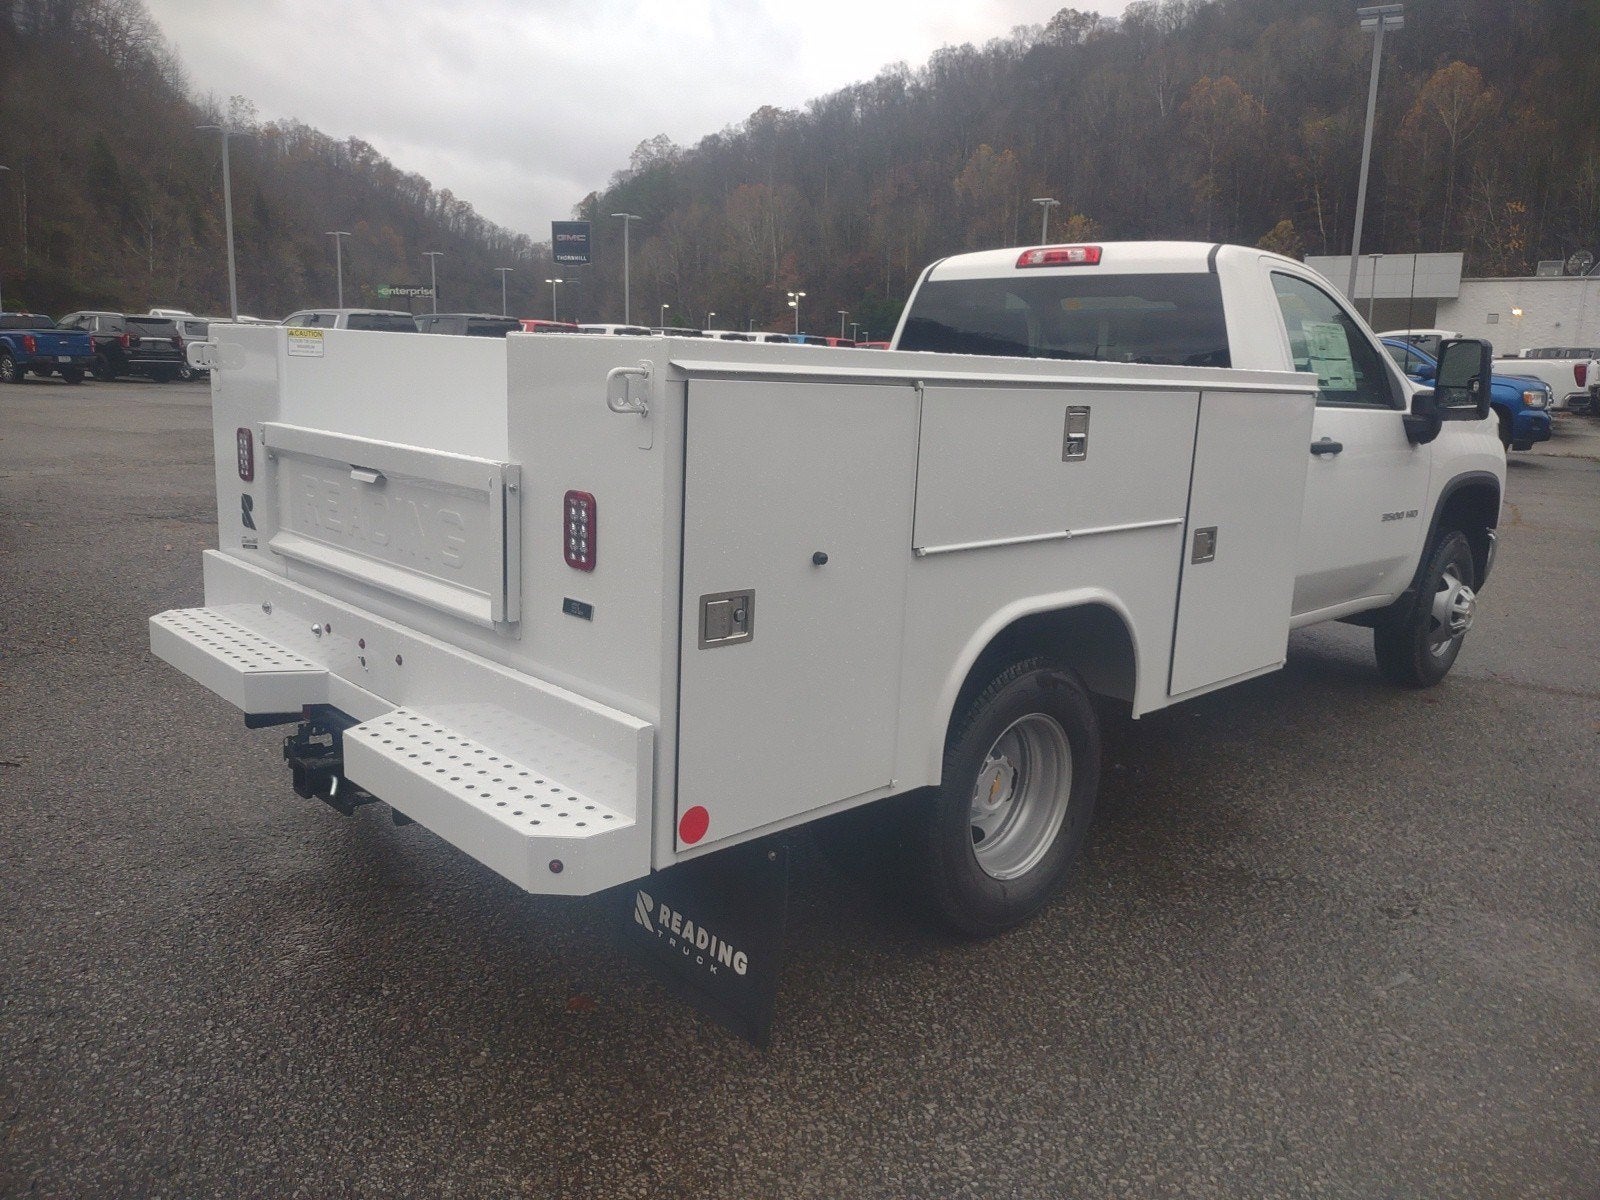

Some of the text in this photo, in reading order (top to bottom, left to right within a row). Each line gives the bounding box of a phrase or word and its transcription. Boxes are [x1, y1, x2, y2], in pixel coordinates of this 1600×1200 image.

[380, 286, 435, 297] enterprise
[294, 330, 322, 338] CAUTION
[657, 929, 718, 975] TRUCK
[659, 903, 748, 975] READING
